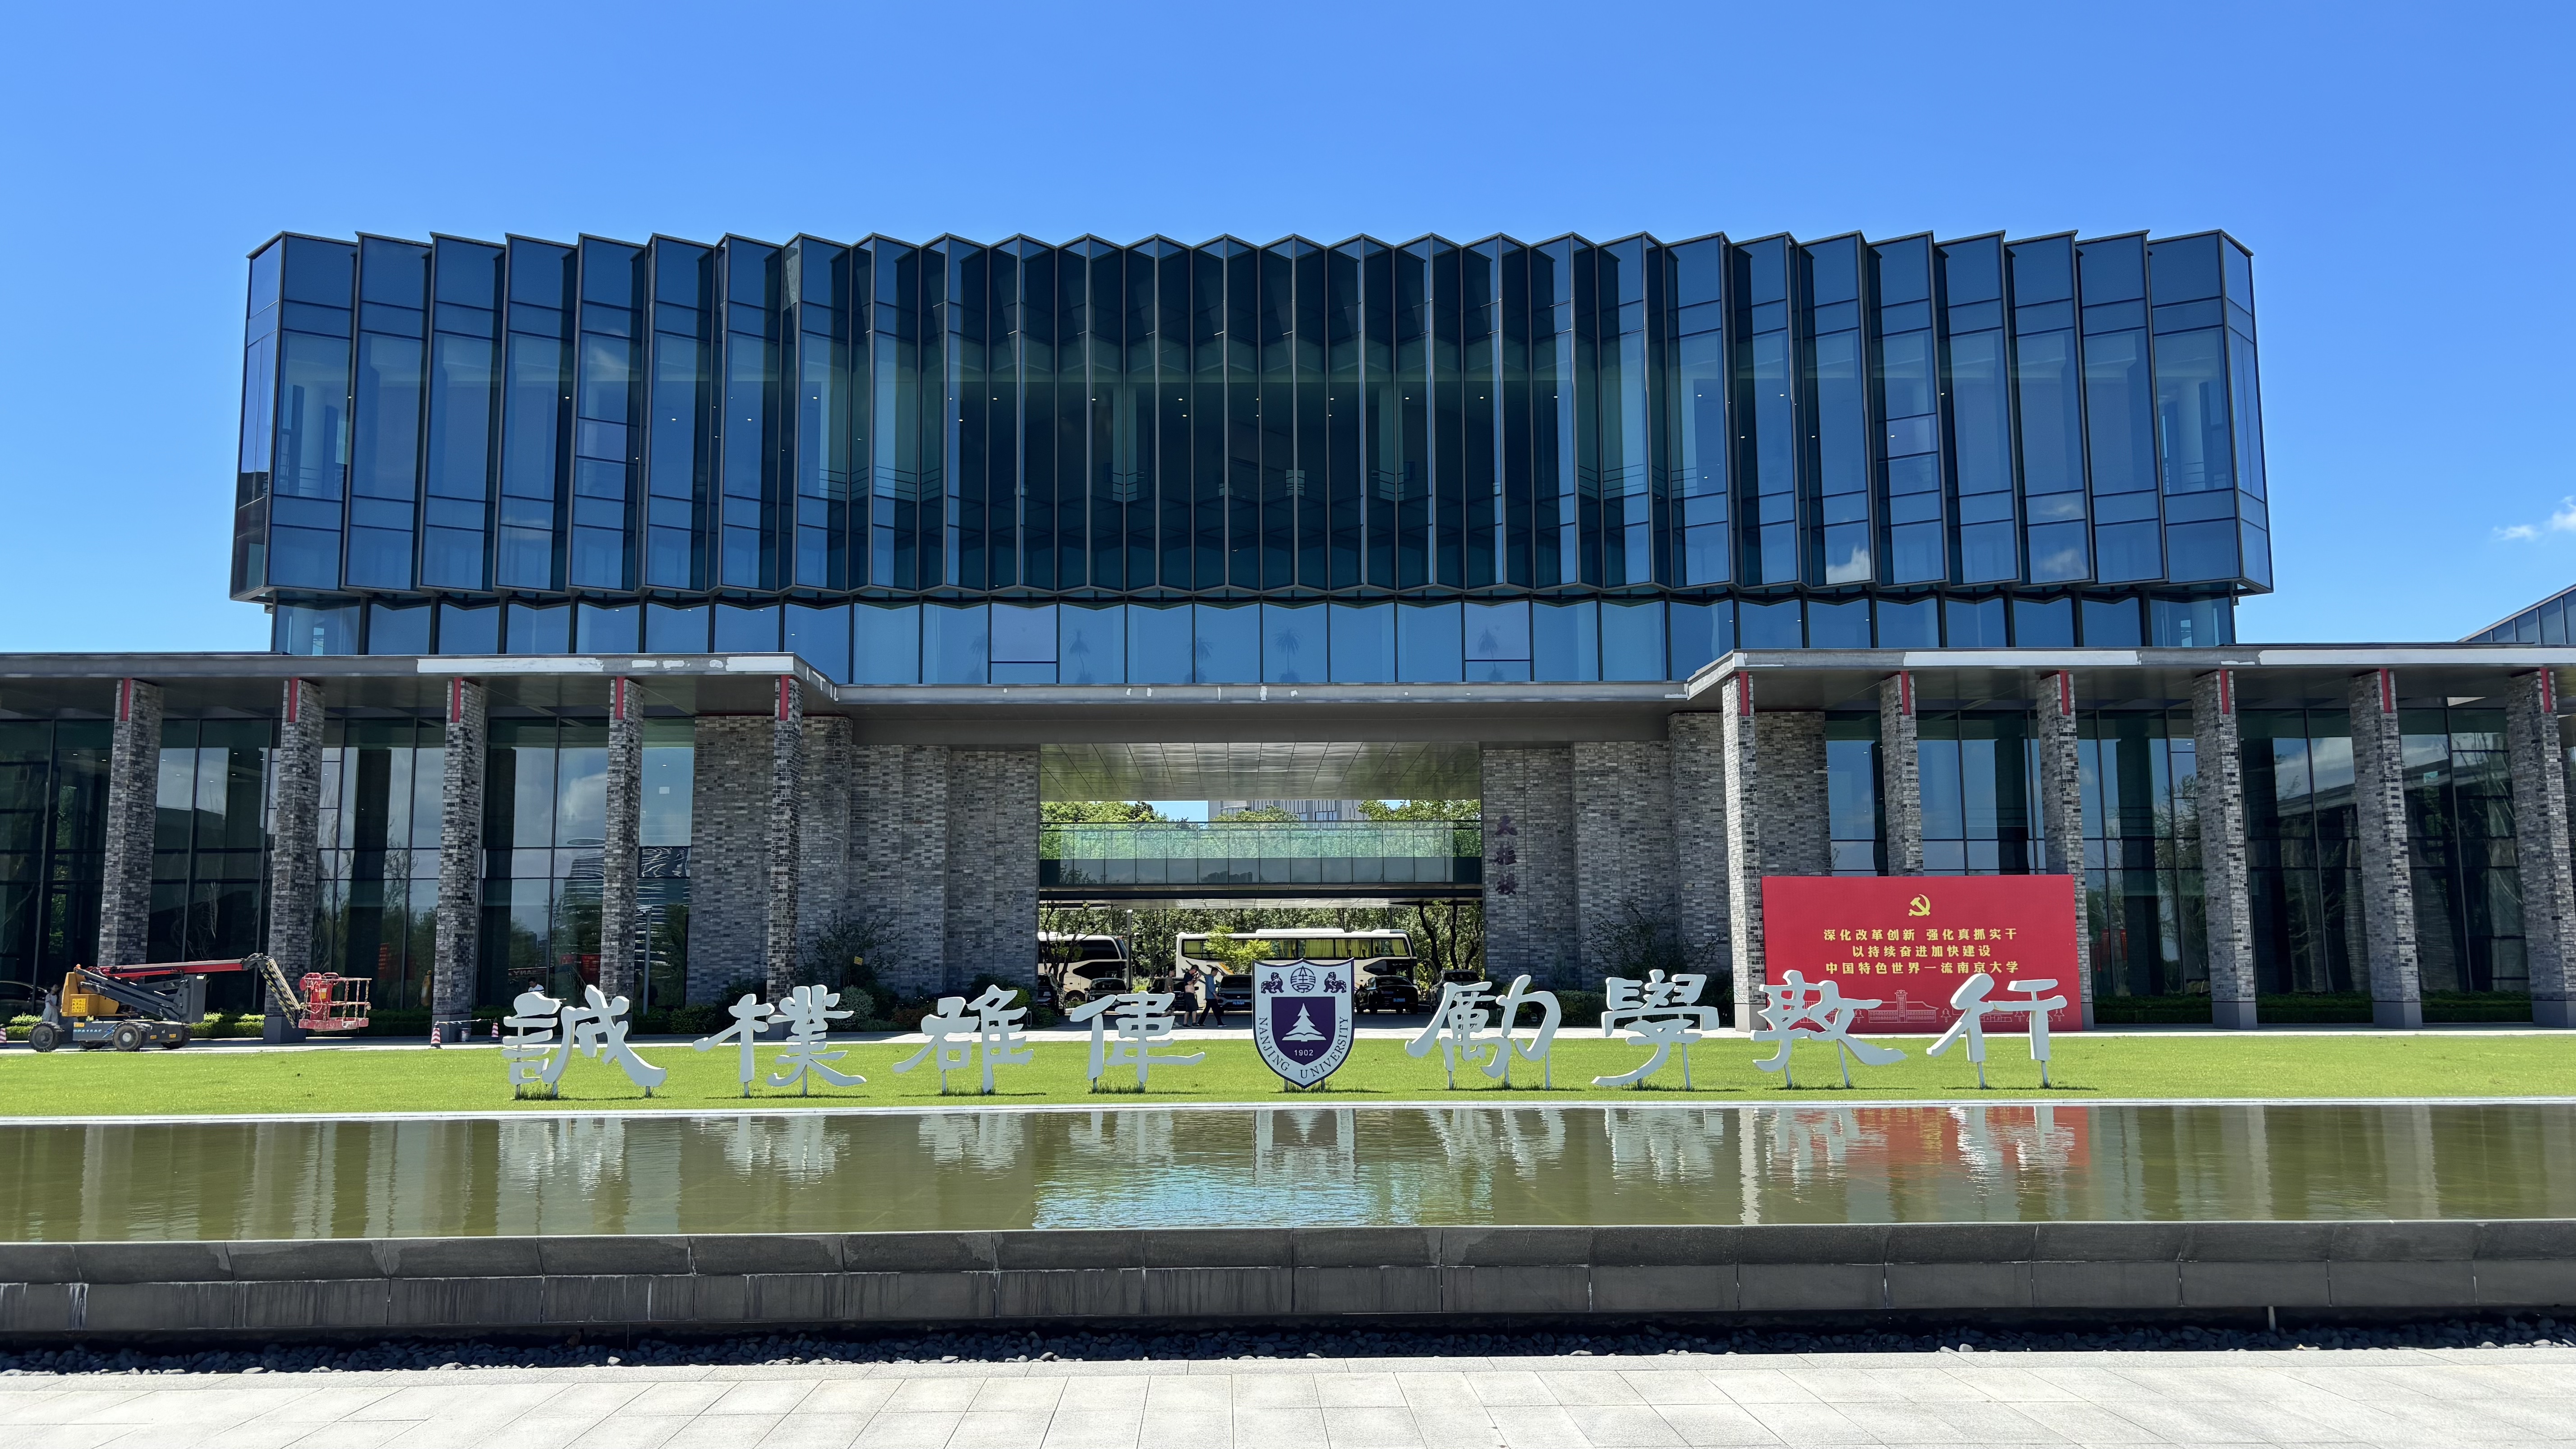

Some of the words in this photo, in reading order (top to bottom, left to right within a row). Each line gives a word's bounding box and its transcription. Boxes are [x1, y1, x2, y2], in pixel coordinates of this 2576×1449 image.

[1823, 929, 1915, 941] 深化改革创新
[1926, 928, 2017, 941] 强化真抓实干
[1852, 945, 1991, 957] 以持续奋进加快建设
[1826, 961, 2019, 975] 中国特色世界一流南京大学
[1259, 1017, 1290, 1072] NANJING
[1300, 1016, 1348, 1079] UNIVERSITY
